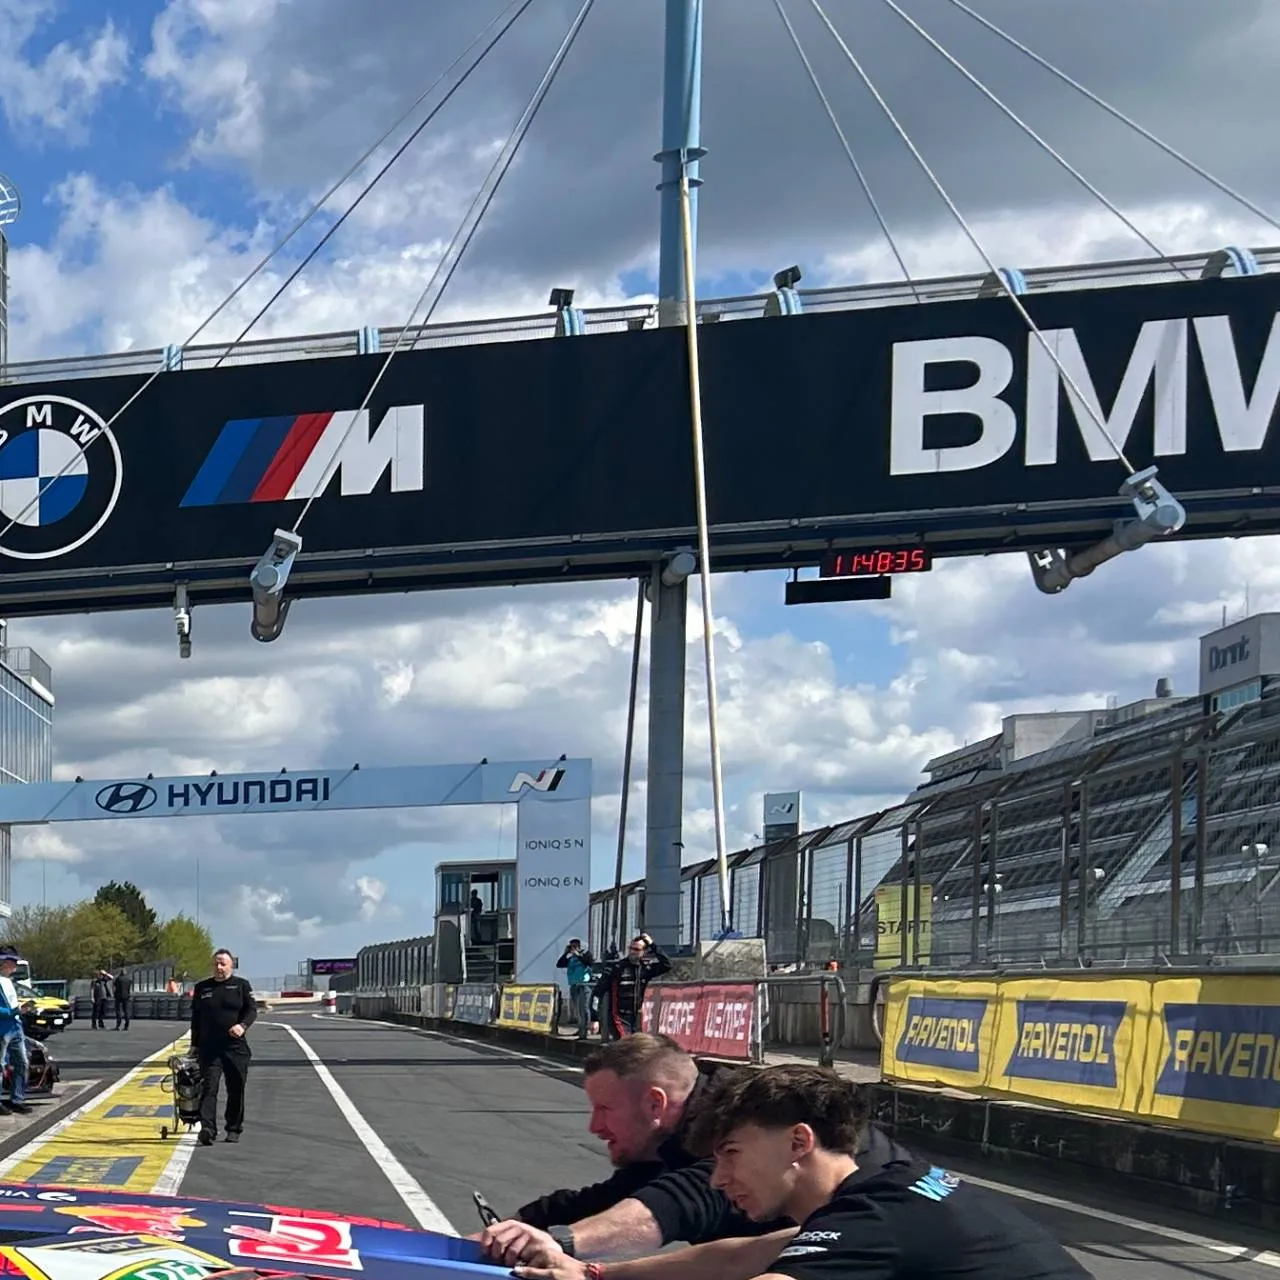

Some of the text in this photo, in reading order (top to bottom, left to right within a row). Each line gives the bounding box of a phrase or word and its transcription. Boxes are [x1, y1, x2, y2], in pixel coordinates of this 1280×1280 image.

[832, 550, 925, 575] 11:48:35
[168, 776, 330, 807] HYUNDAI
[525, 838, 584, 850] IONIQ 5 N
[525, 876, 583, 888] IONIQ 6 N
[659, 1001, 694, 1036] WEMPE
[704, 1002, 750, 1041] WEMPE
[904, 1016, 979, 1054] RAVENOL
[1017, 1022, 1110, 1064] RAVENOL
[1173, 1029, 1280, 1081] RAVEN
